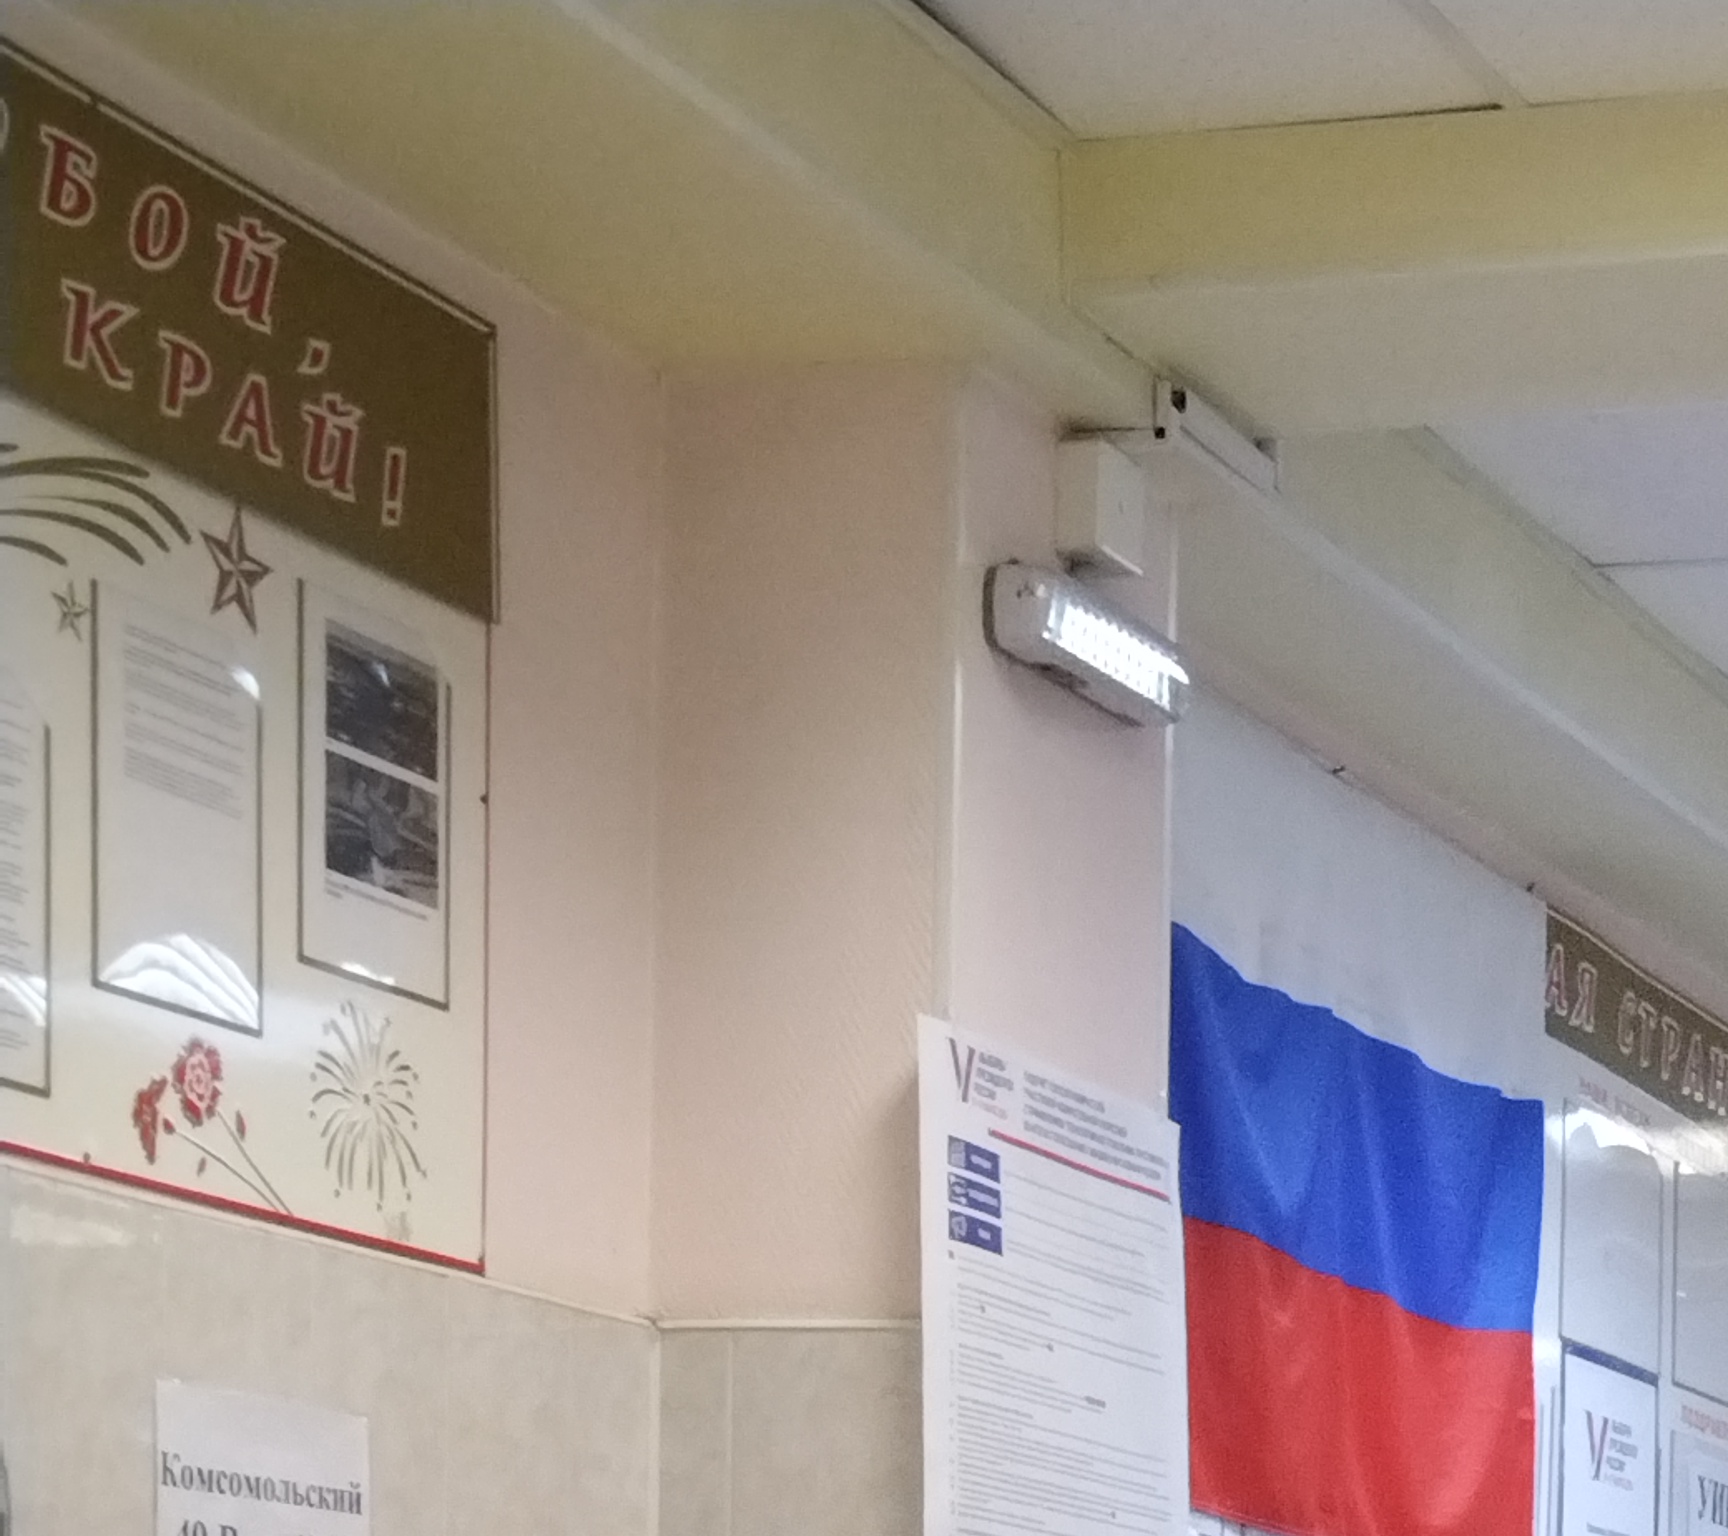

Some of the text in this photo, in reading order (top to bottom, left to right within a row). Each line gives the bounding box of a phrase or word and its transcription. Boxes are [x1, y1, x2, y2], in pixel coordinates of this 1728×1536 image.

[0, 98, 330, 376] БОЙ,
[61, 279, 408, 527] КРАЙ!
[160, 1450, 363, 1516] Комсомольский
